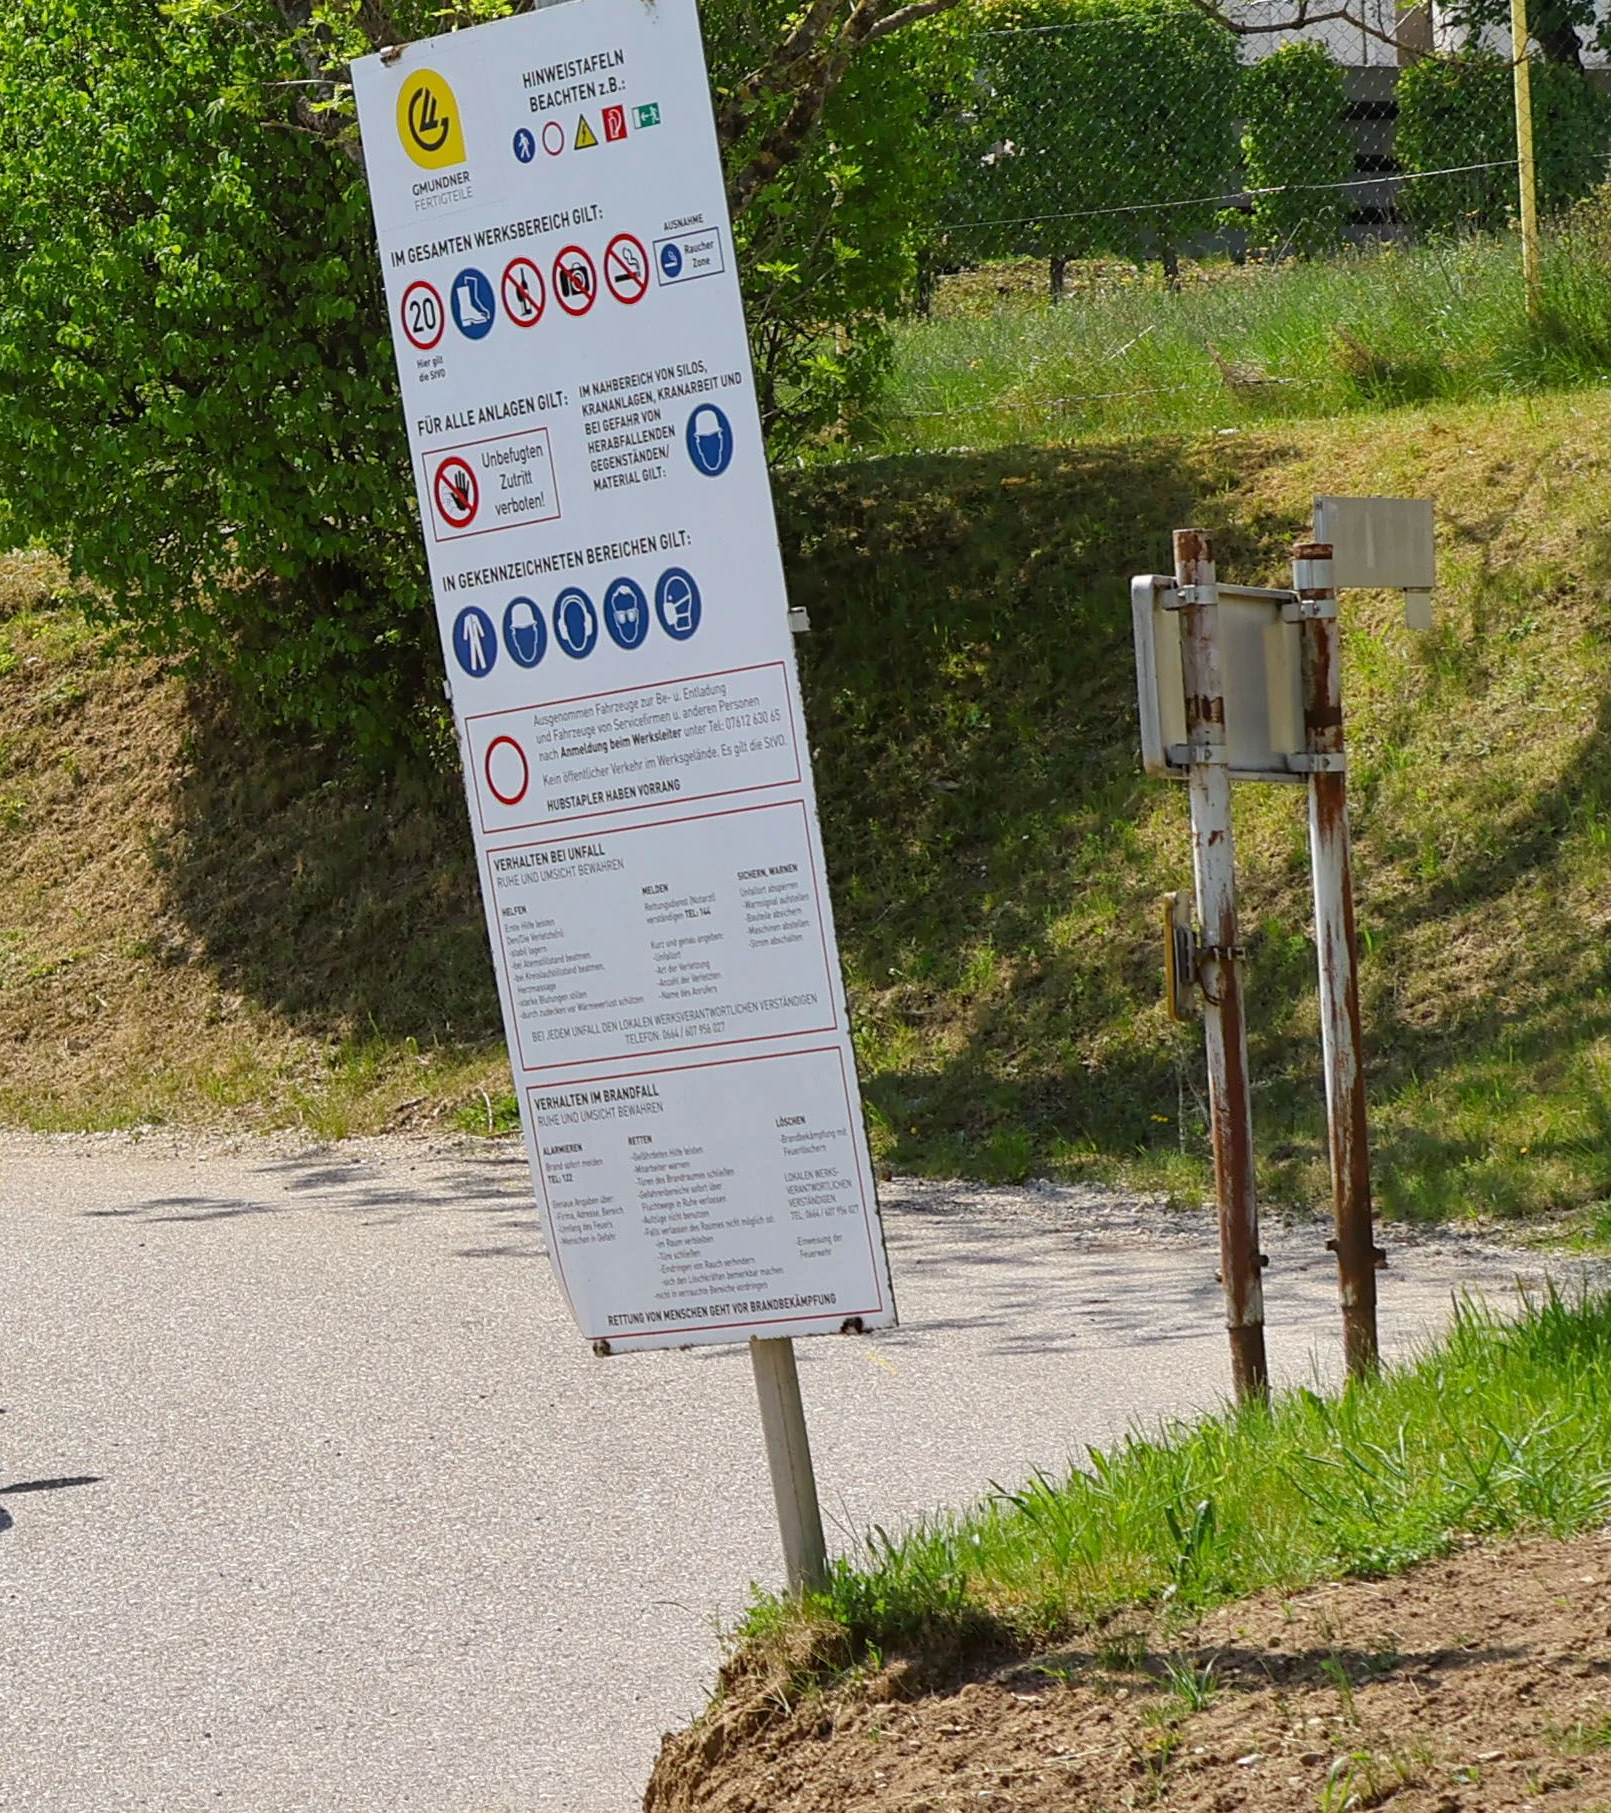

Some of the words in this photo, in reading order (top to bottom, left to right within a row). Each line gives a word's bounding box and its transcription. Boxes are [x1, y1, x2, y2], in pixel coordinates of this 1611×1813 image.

[522, 49, 624, 88] HINWEISTAFELN
[529, 82, 596, 113] BEACHTEN
[598, 76, 626, 96] z.B.:
[412, 171, 470, 196] GMUNDNER
[414, 186, 473, 211] FERTIGTEILE
[391, 250, 406, 267] IM
[407, 234, 473, 263] GESAMTEN
[474, 211, 570, 248] WERKSBEREICH
[572, 204, 603, 225] GILT:
[664, 213, 704, 231] AUSNAHME
[684, 241, 714, 254] Raucher
[692, 257, 711, 268] Zone
[408, 296, 437, 334] 20
[416, 359, 431, 369] Hier
[579, 385, 591, 398] IM
[592, 371, 654, 396] NAHBEREICH
[654, 366, 675, 382] VON
[676, 360, 708, 377] SILOS,
[582, 390, 656, 417] KRANANLAGEN,
[657, 376, 718, 401] KRANARBEIT
[720, 372, 742, 387] UND
[417, 416, 443, 436] FÜR
[445, 409, 476, 431] ALLE
[478, 397, 535, 424] ANLAGEN
[537, 390, 568, 411] GILT:
[584, 421, 601, 436] BEI
[602, 412, 640, 432] GEFAHR
[640, 408, 661, 423] VON
[587, 425, 675, 454] HERABFALLENDEN
[481, 445, 543, 468] Unbefugten
[590, 444, 669, 473] GEGENSTÄNDEN/
[499, 470, 533, 490] Zutritt
[593, 471, 641, 491] MATERIAL
[642, 466, 666, 481] GILT:
[495, 491, 545, 516] verboten!
[442, 575, 456, 592] IN
[458, 550, 584, 589] GEKENNZEICHNETEN
[586, 536, 657, 564] BEREICHEN
[659, 530, 691, 550] GILT:
[533, 707, 595, 728] Ausgenommen
[595, 700, 639, 716] Fahrzeuge
[640, 696, 654, 708] zur
[682, 683, 727, 700] Entladung
[536, 730, 552, 744] und
[552, 725, 596, 741] Fahrzeuge
[597, 722, 613, 733] von
[613, 712, 671, 733] Servicefirmen
[682, 704, 718, 719] anderen
[718, 697, 760, 712] Personen
[539, 748, 559, 761] nach
[561, 741, 609, 758] Anmeldung
[609, 736, 631, 750] beim
[631, 728, 682, 746] Werksleiter
[684, 725, 707, 737] unter
[542, 774, 562, 787] Kein
[562, 766, 609, 783] öffentlicher
[609, 759, 643, 775] Verkehr
[644, 757, 657, 769] im
[720, 743, 733, 757] Es
[749, 738, 763, 751] die
[547, 791, 604, 811] HUBSTAPLER
[605, 786, 637, 802] HABEN
[637, 778, 680, 796] VORRANG
[493, 852, 549, 871] VERHALTEN
[550, 849, 566, 863] BEI
[567, 843, 605, 861] UNFALL
[496, 874, 520, 889] RUHE
[520, 871, 539, 885] UND
[539, 865, 576, 882] UMSICHT
[577, 858, 624, 876] BEWAHREN
[642, 884, 669, 895] MELDEN
[501, 906, 527, 917] HELFEN
[531, 1030, 545, 1043] BEI
[546, 1027, 571, 1041] JEDEM
[571, 1023, 601, 1037] UNFALL
[601, 1021, 618, 1033] DEN
[618, 1016, 654, 1031] LOKALEN
[759, 993, 818, 1011] VERSTÄNDIGEN
[534, 1092, 589, 1111] VERHALTEN
[590, 1091, 602, 1104] IM
[603, 1084, 659, 1103] BRANDFALL
[537, 1111, 561, 1127] RUHE
[560, 1111, 579, 1125] UND
[579, 1106, 615, 1122] UMSICHT
[617, 1101, 664, 1118] BEWAHREN
[628, 1135, 652, 1145] RETTEN
[607, 1312, 645, 1326] RETTUNG
[645, 1311, 662, 1322] VON
[663, 1306, 708, 1321] MENSCHEN
[709, 1303, 730, 1317] GEHT
[731, 1302, 749, 1314] VOR
[750, 1293, 837, 1313] BRANDBEKÄMPFUNG
